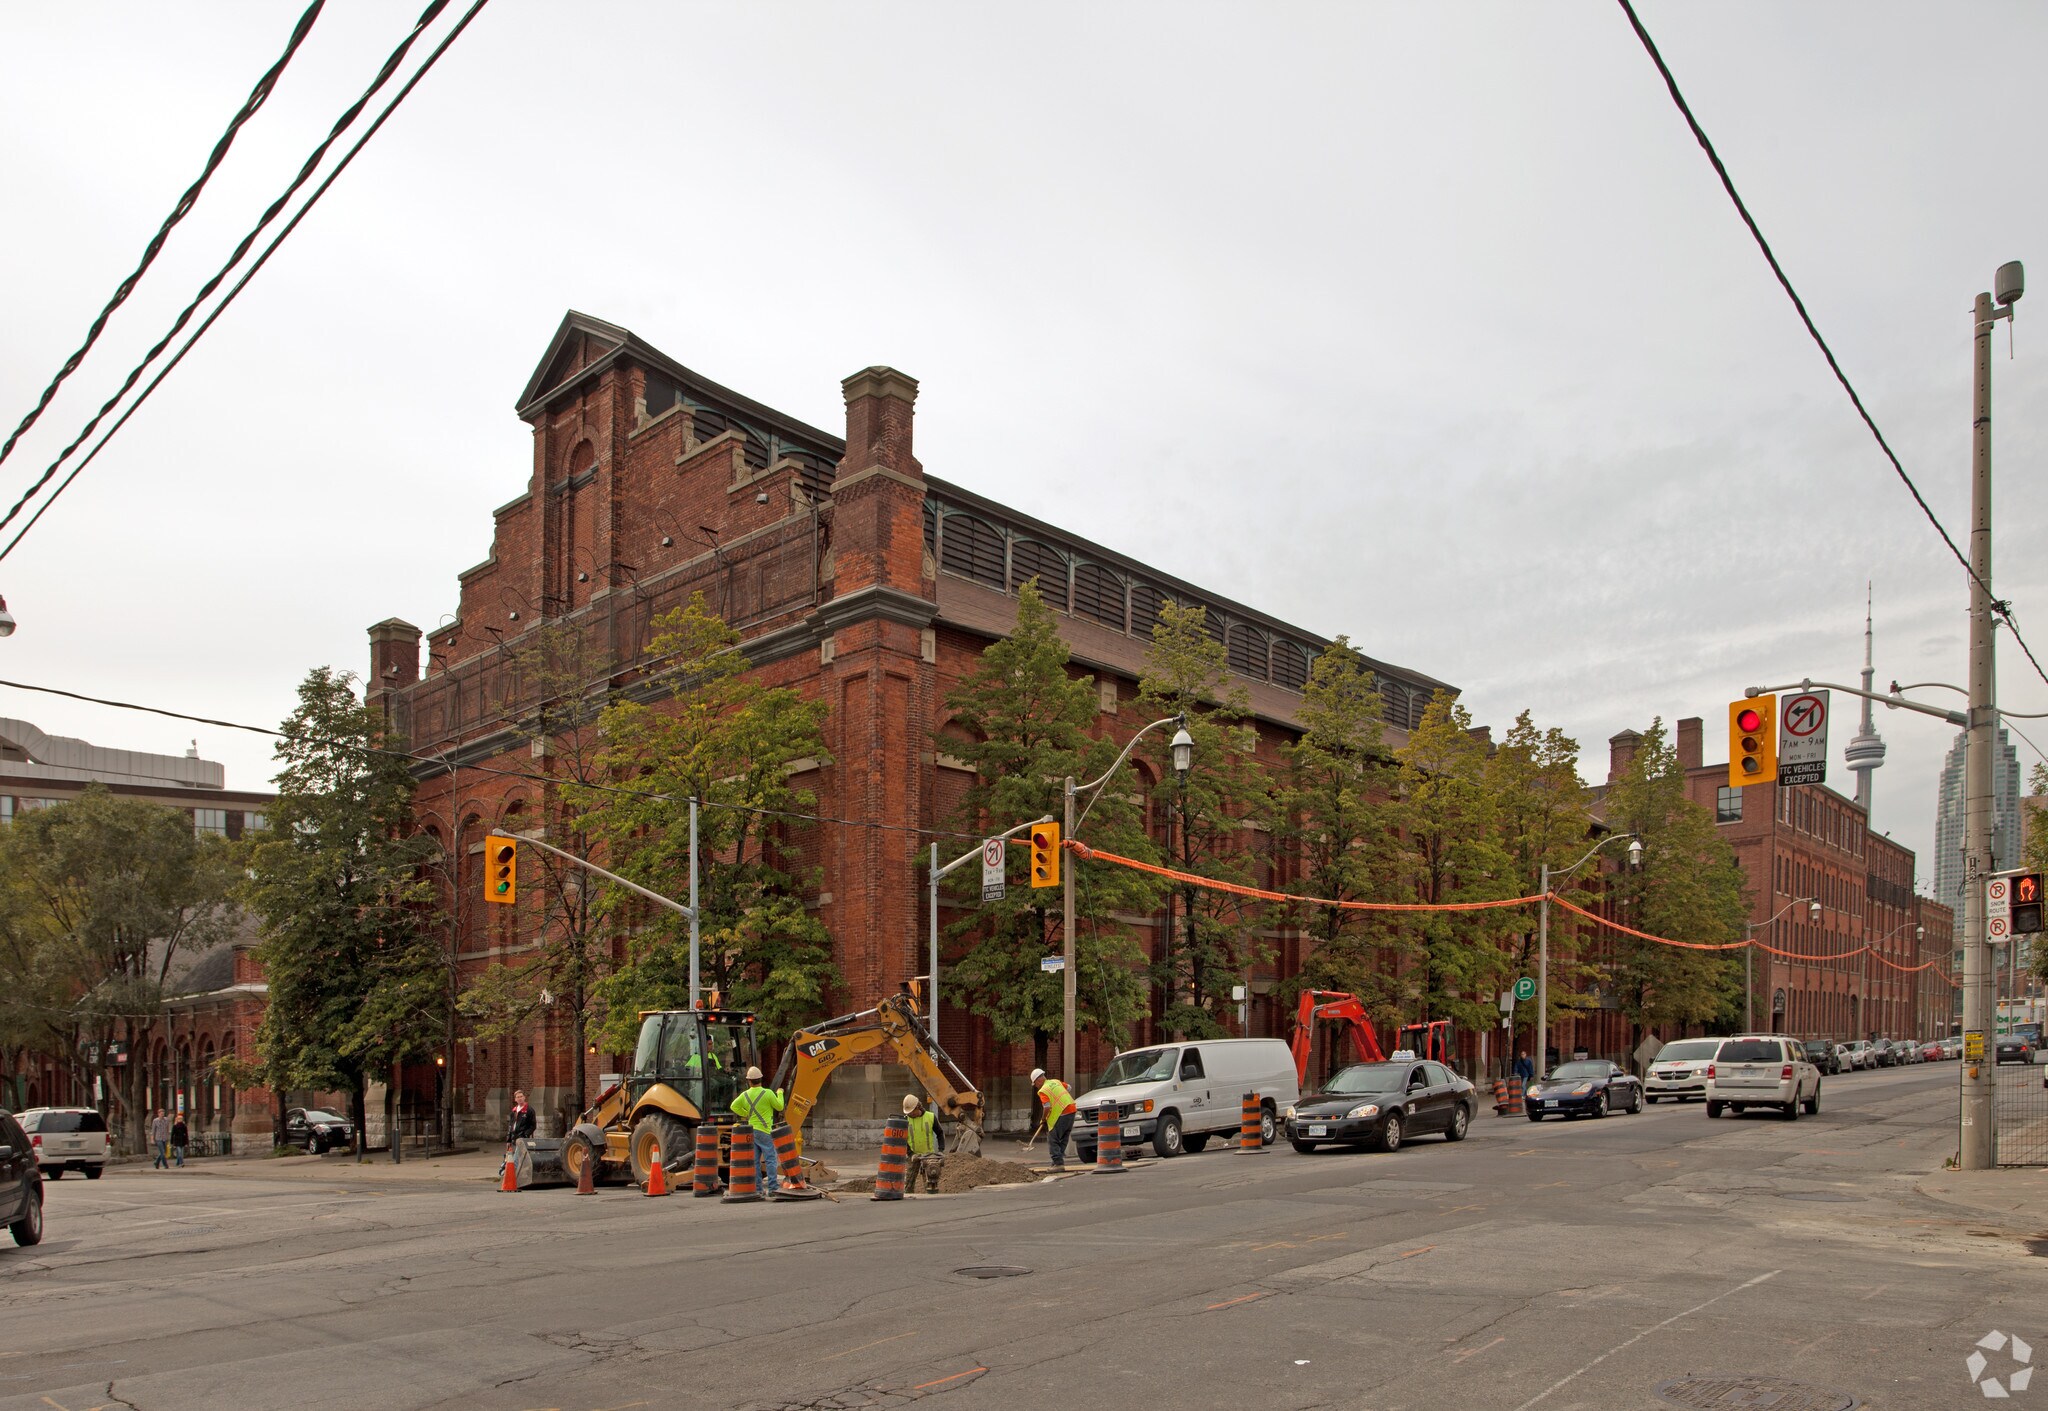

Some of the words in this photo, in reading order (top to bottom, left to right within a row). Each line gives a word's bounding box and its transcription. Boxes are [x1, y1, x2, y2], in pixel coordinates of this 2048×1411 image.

[1780, 766, 1792, 775] TTC
[1793, 762, 1826, 774] VEHICLES
[1784, 773, 1819, 784] EXCEPTED
[1520, 981, 1531, 994] P
[808, 1040, 827, 1057] CAT
[892, 1128, 904, 1138] GIO
